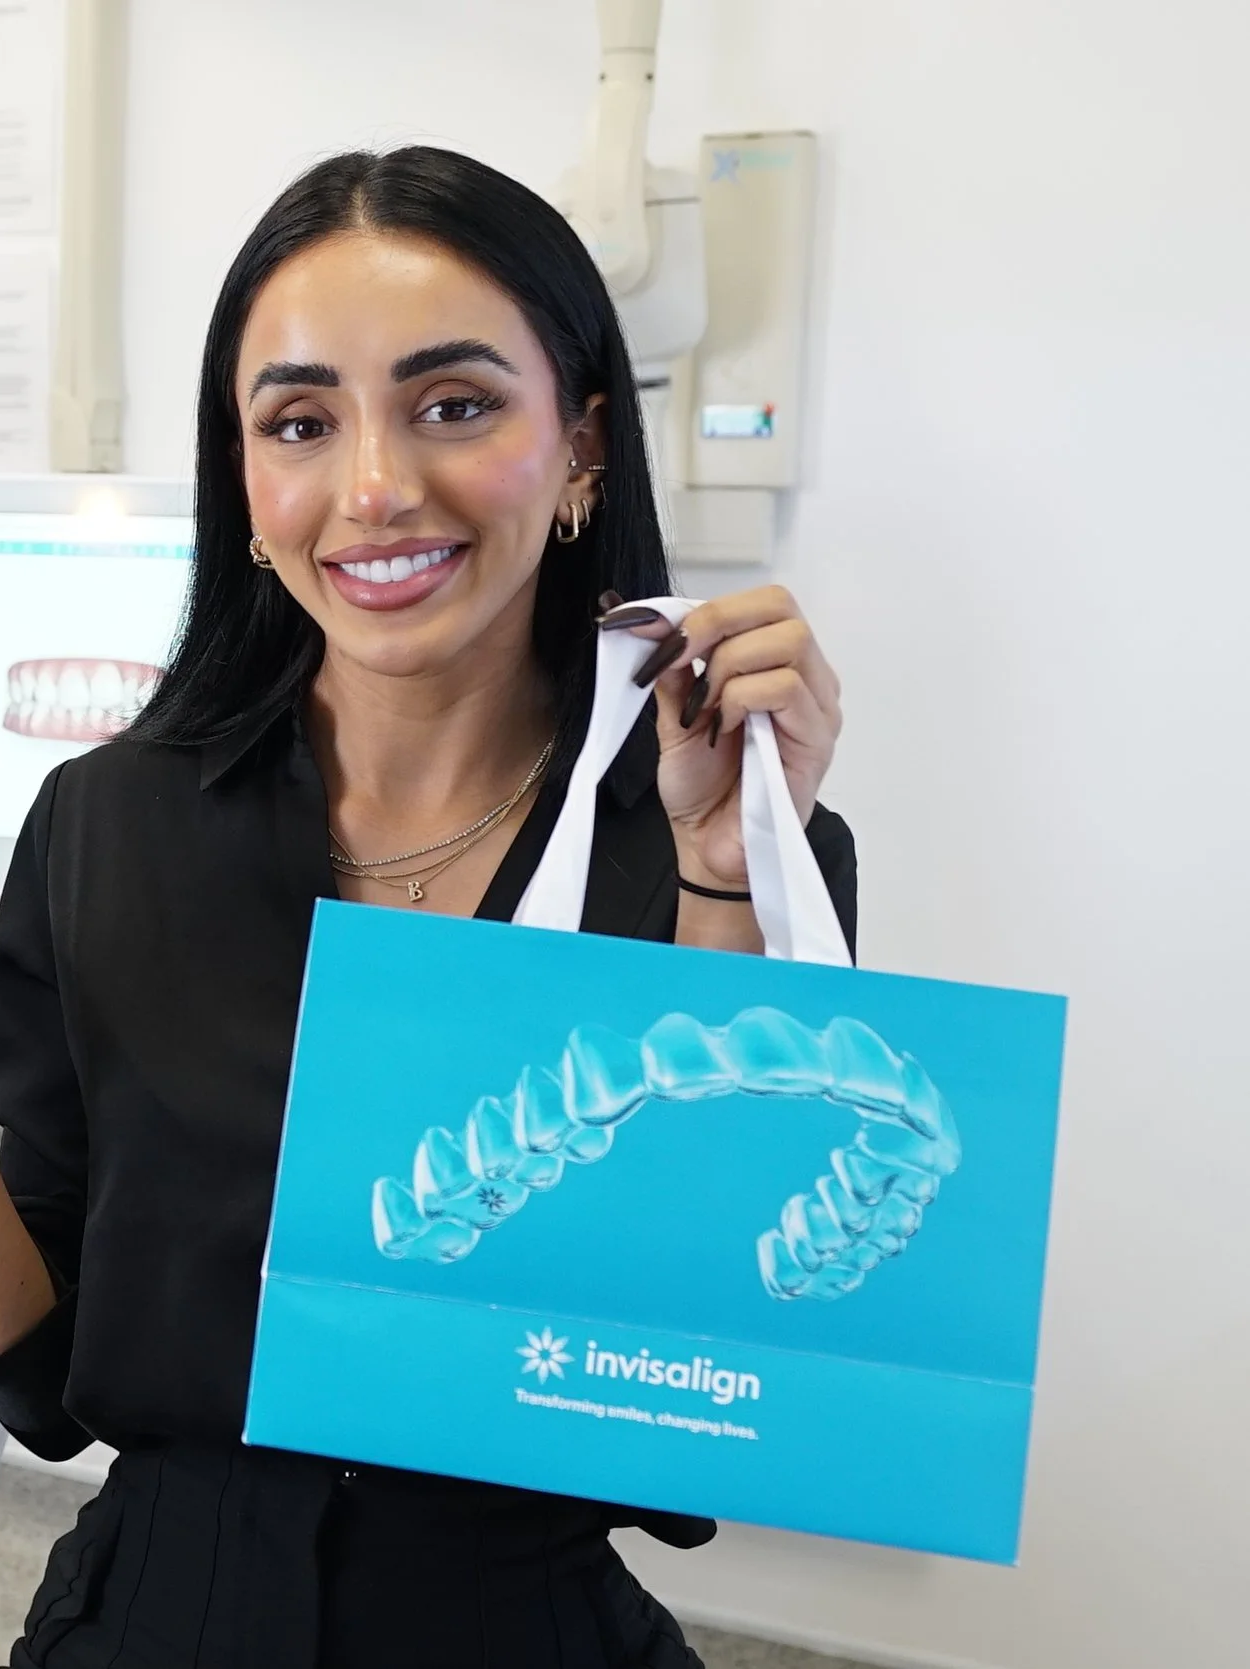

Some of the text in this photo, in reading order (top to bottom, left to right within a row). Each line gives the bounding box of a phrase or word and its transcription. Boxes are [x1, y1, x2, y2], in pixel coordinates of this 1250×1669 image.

[407, 881, 423, 901] B
[585, 1340, 761, 1405] invisalign
[515, 1388, 759, 1440] Transforming smiles, changing lives.
